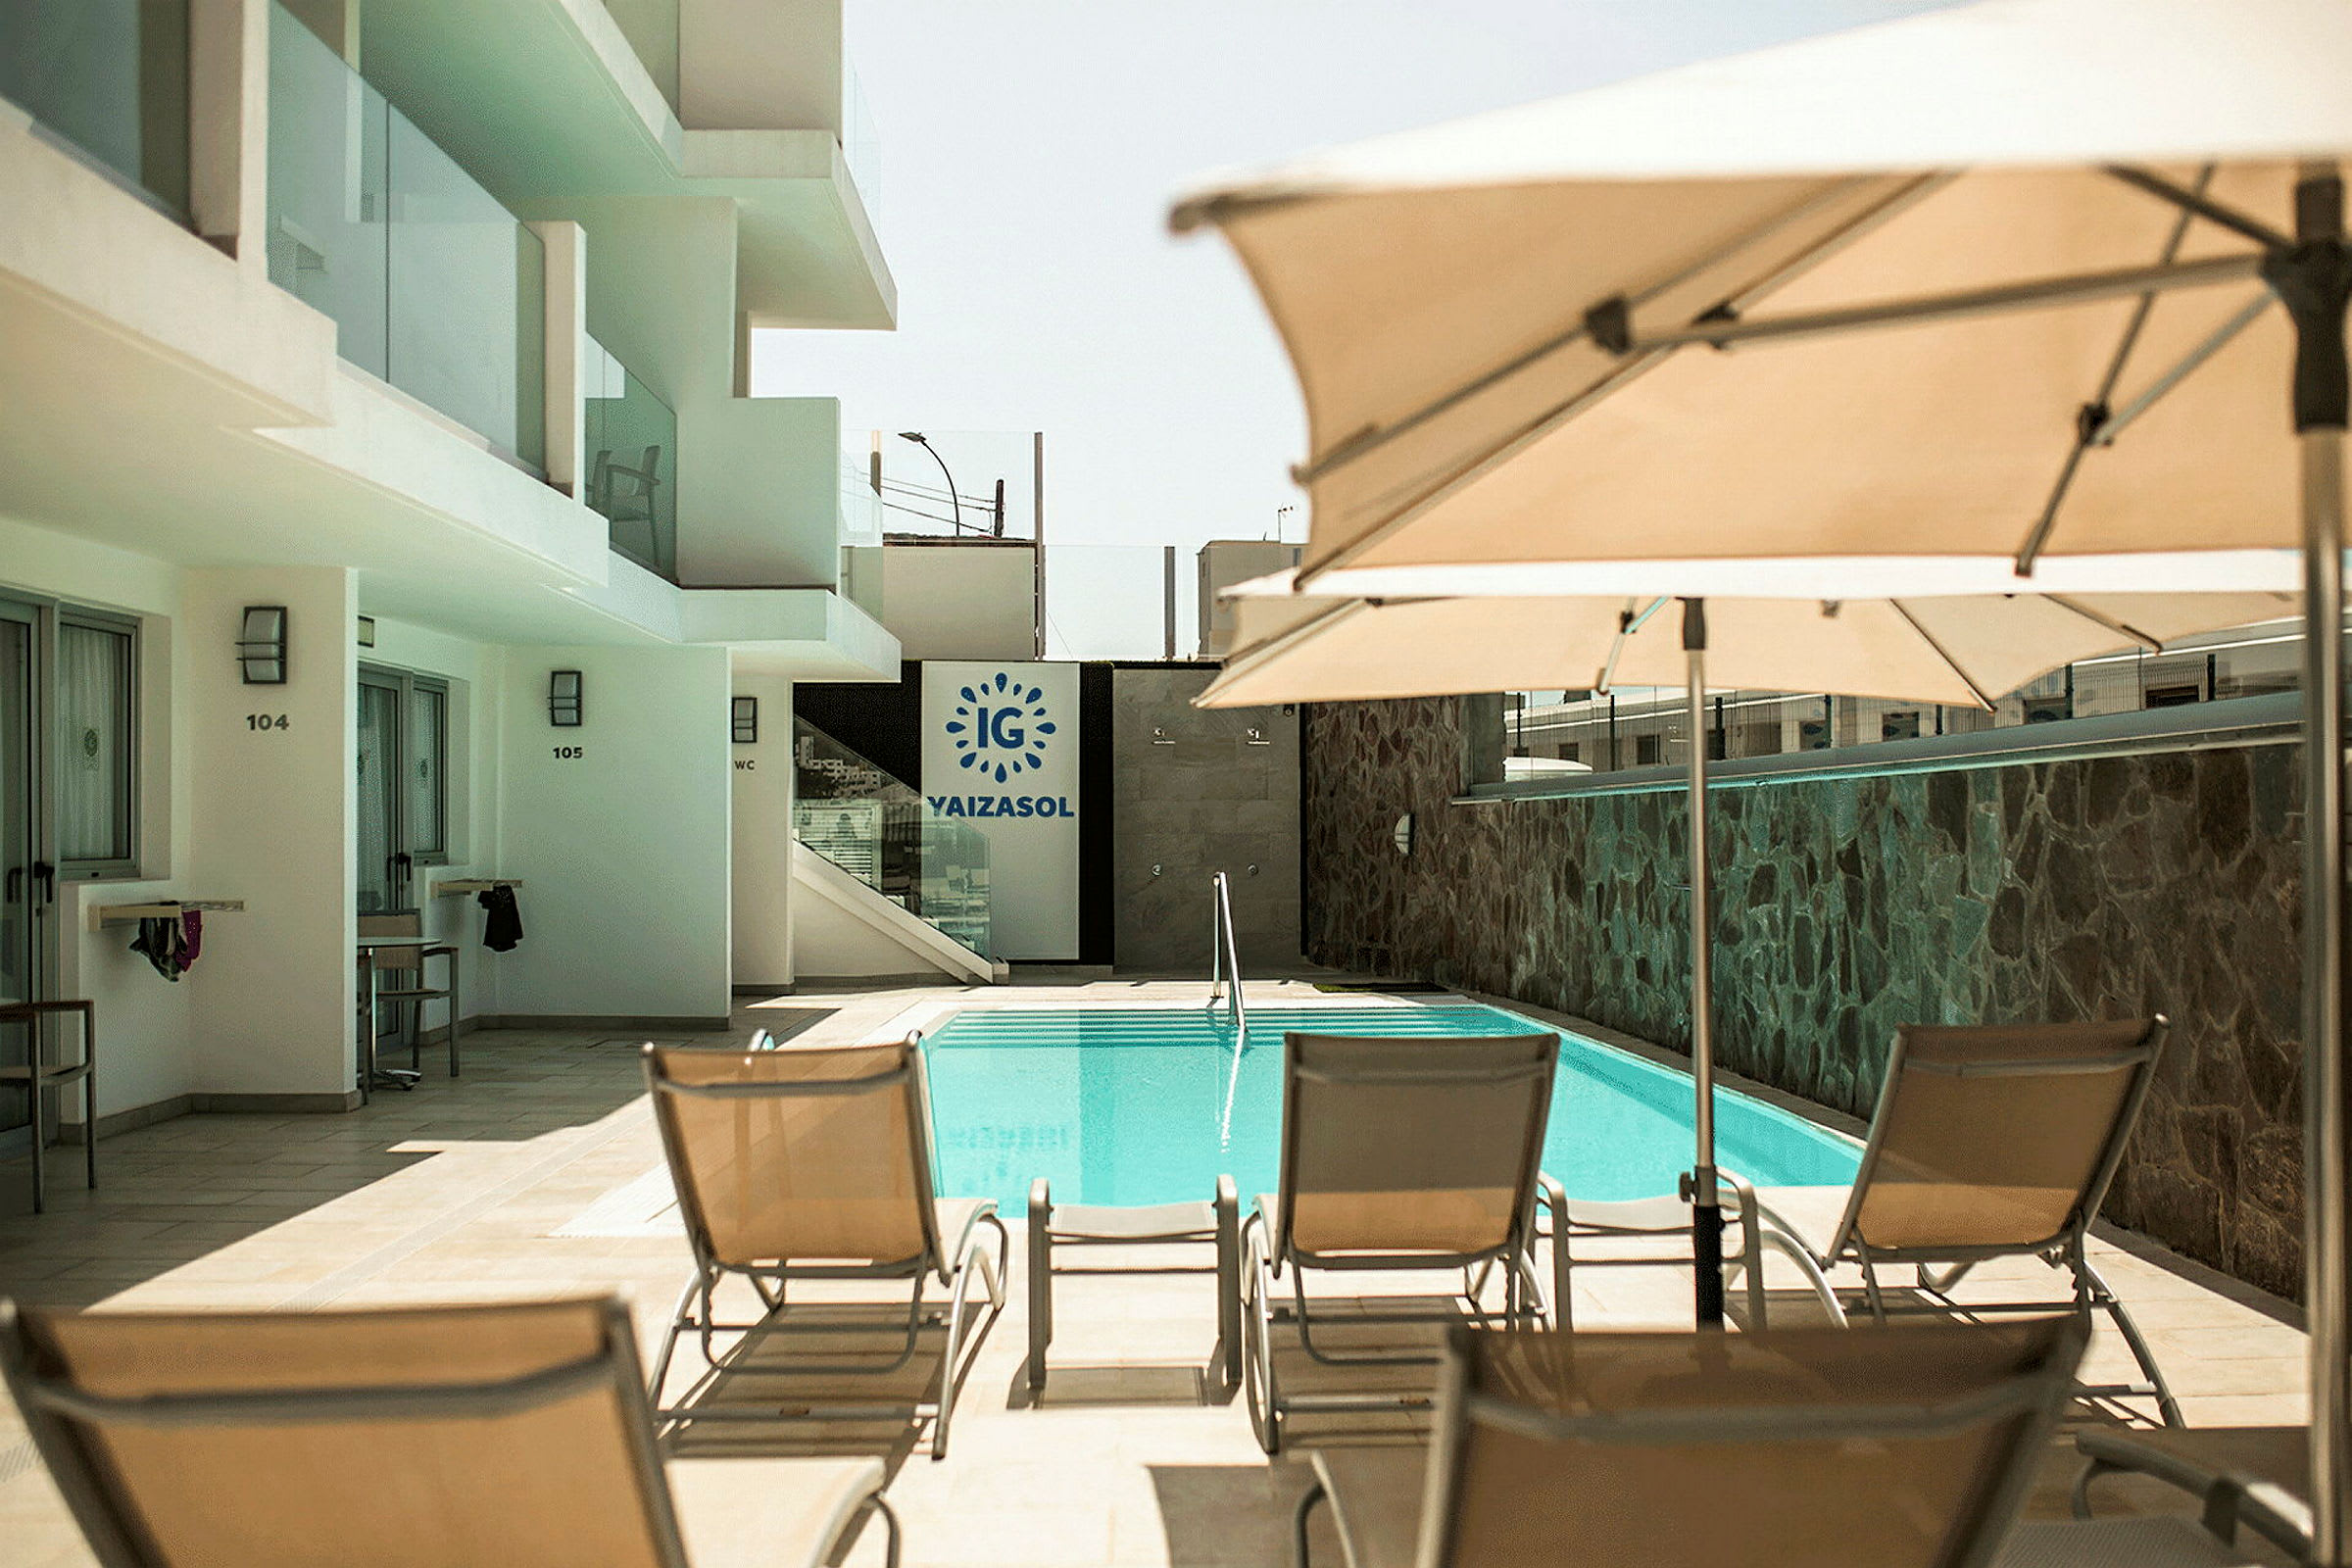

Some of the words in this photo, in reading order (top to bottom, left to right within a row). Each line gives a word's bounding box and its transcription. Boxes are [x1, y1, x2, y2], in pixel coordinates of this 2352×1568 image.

[246, 713, 290, 731] 104
[977, 707, 1024, 749] IG
[553, 747, 583, 760] 105
[734, 760, 755, 770] WC
[927, 796, 1075, 817] YAIZASOL
